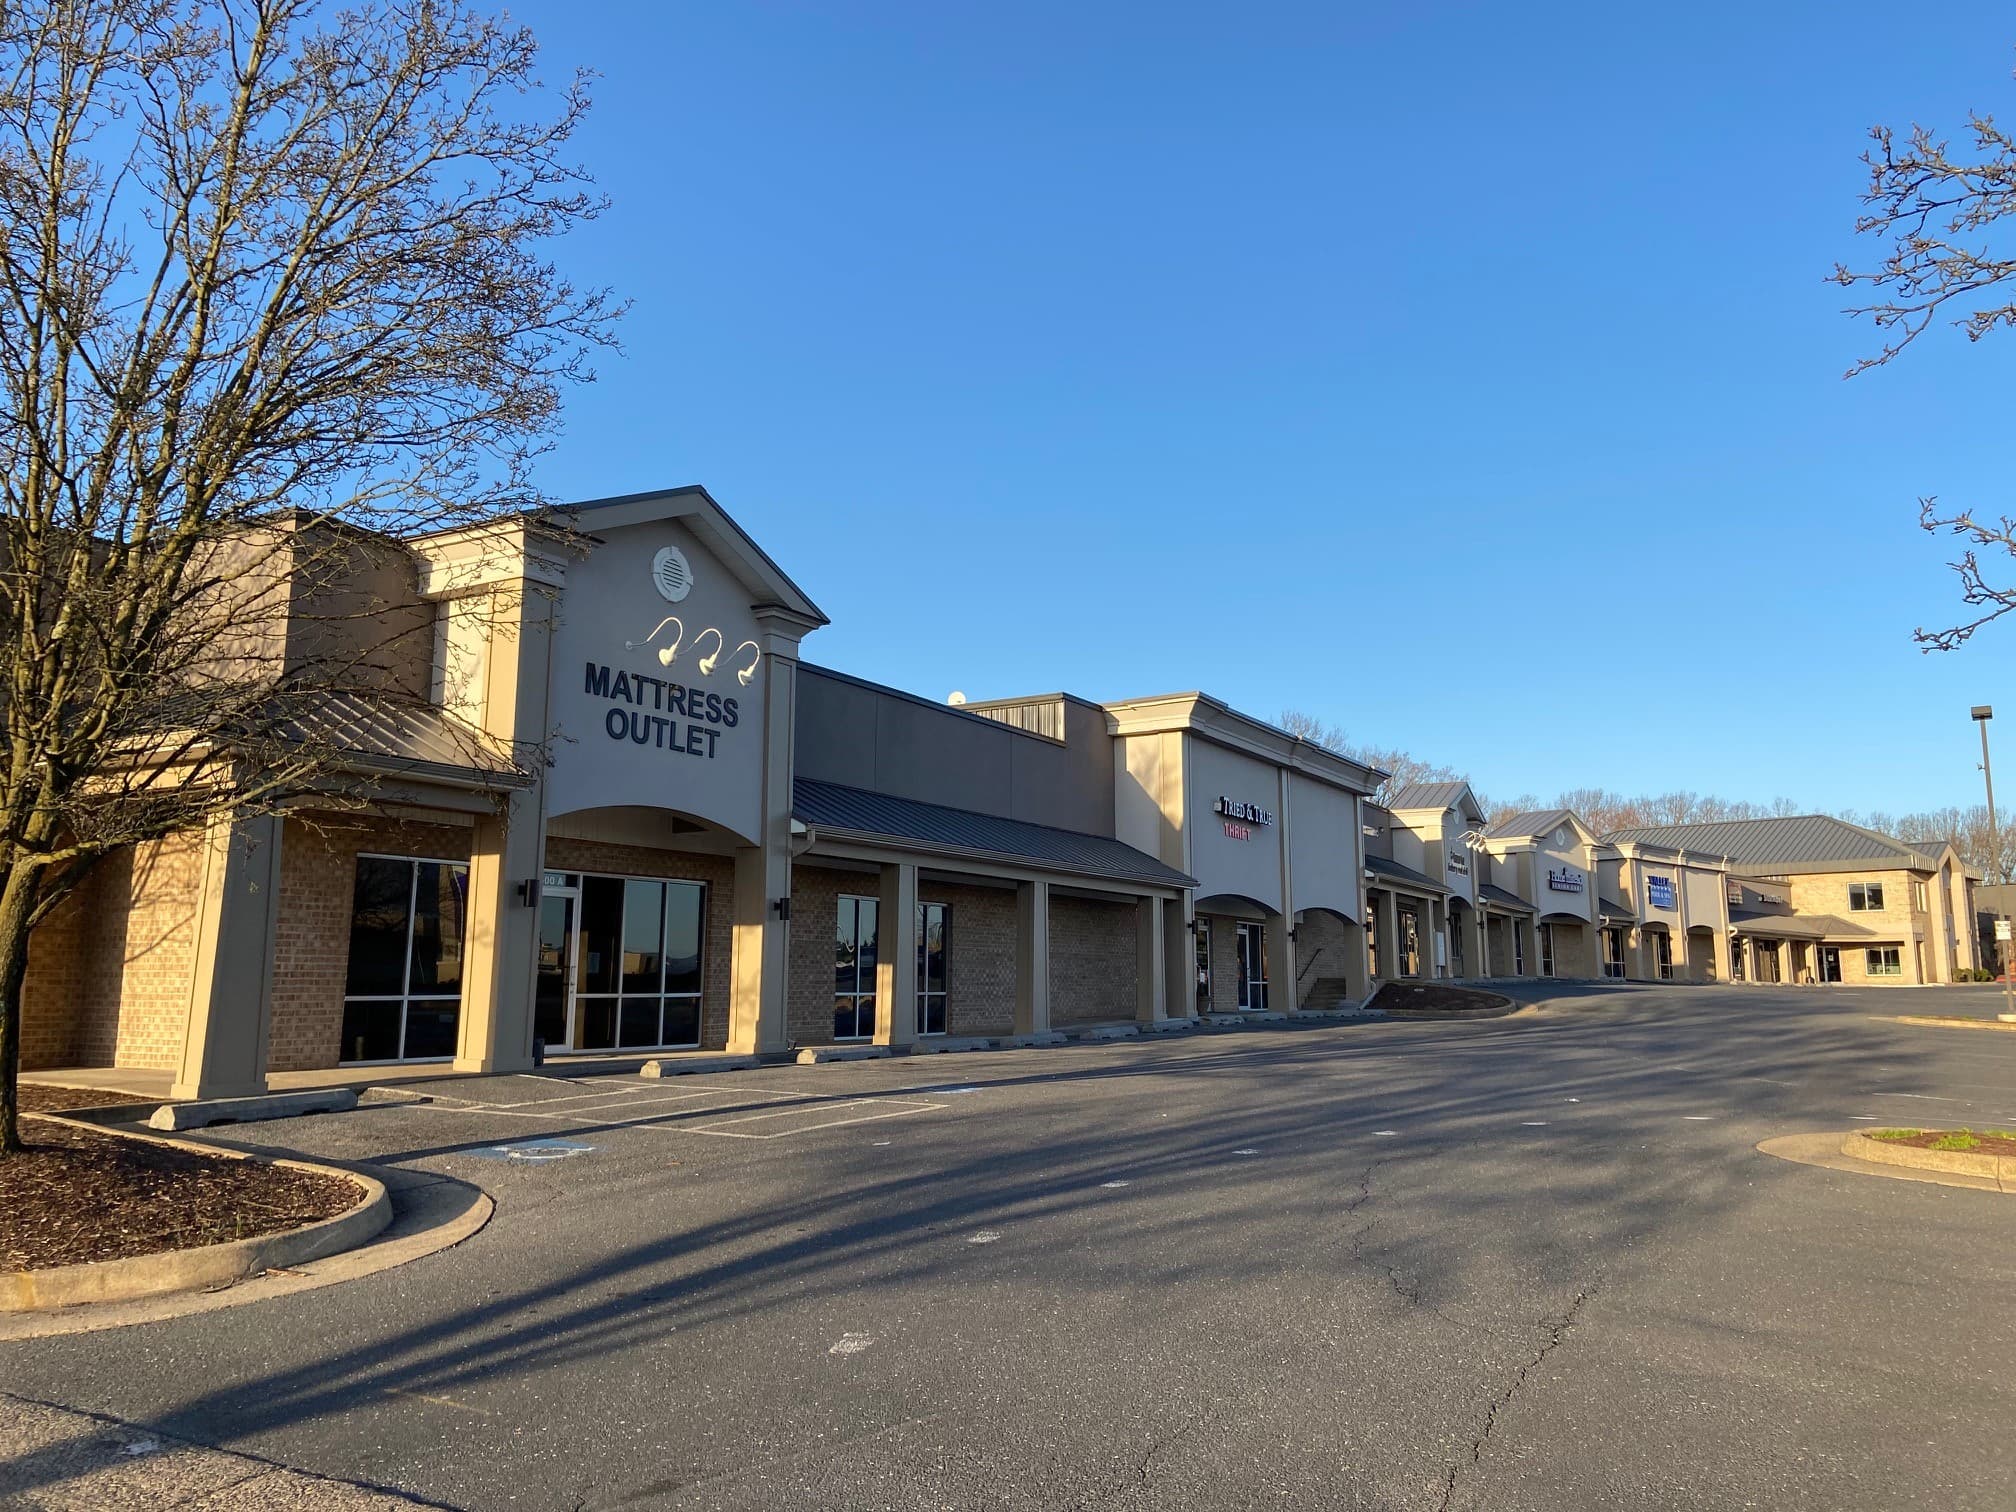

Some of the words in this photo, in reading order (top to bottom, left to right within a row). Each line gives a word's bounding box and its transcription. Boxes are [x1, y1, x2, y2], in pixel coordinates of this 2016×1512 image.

[585, 662, 738, 727] MATTRESS
[606, 708, 720, 759] OUTLET
[1222, 796, 1245, 818] TRIED
[1246, 803, 1253, 821] &
[1254, 805, 1272, 825] TRUE
[1225, 821, 1251, 840] THRIFT
